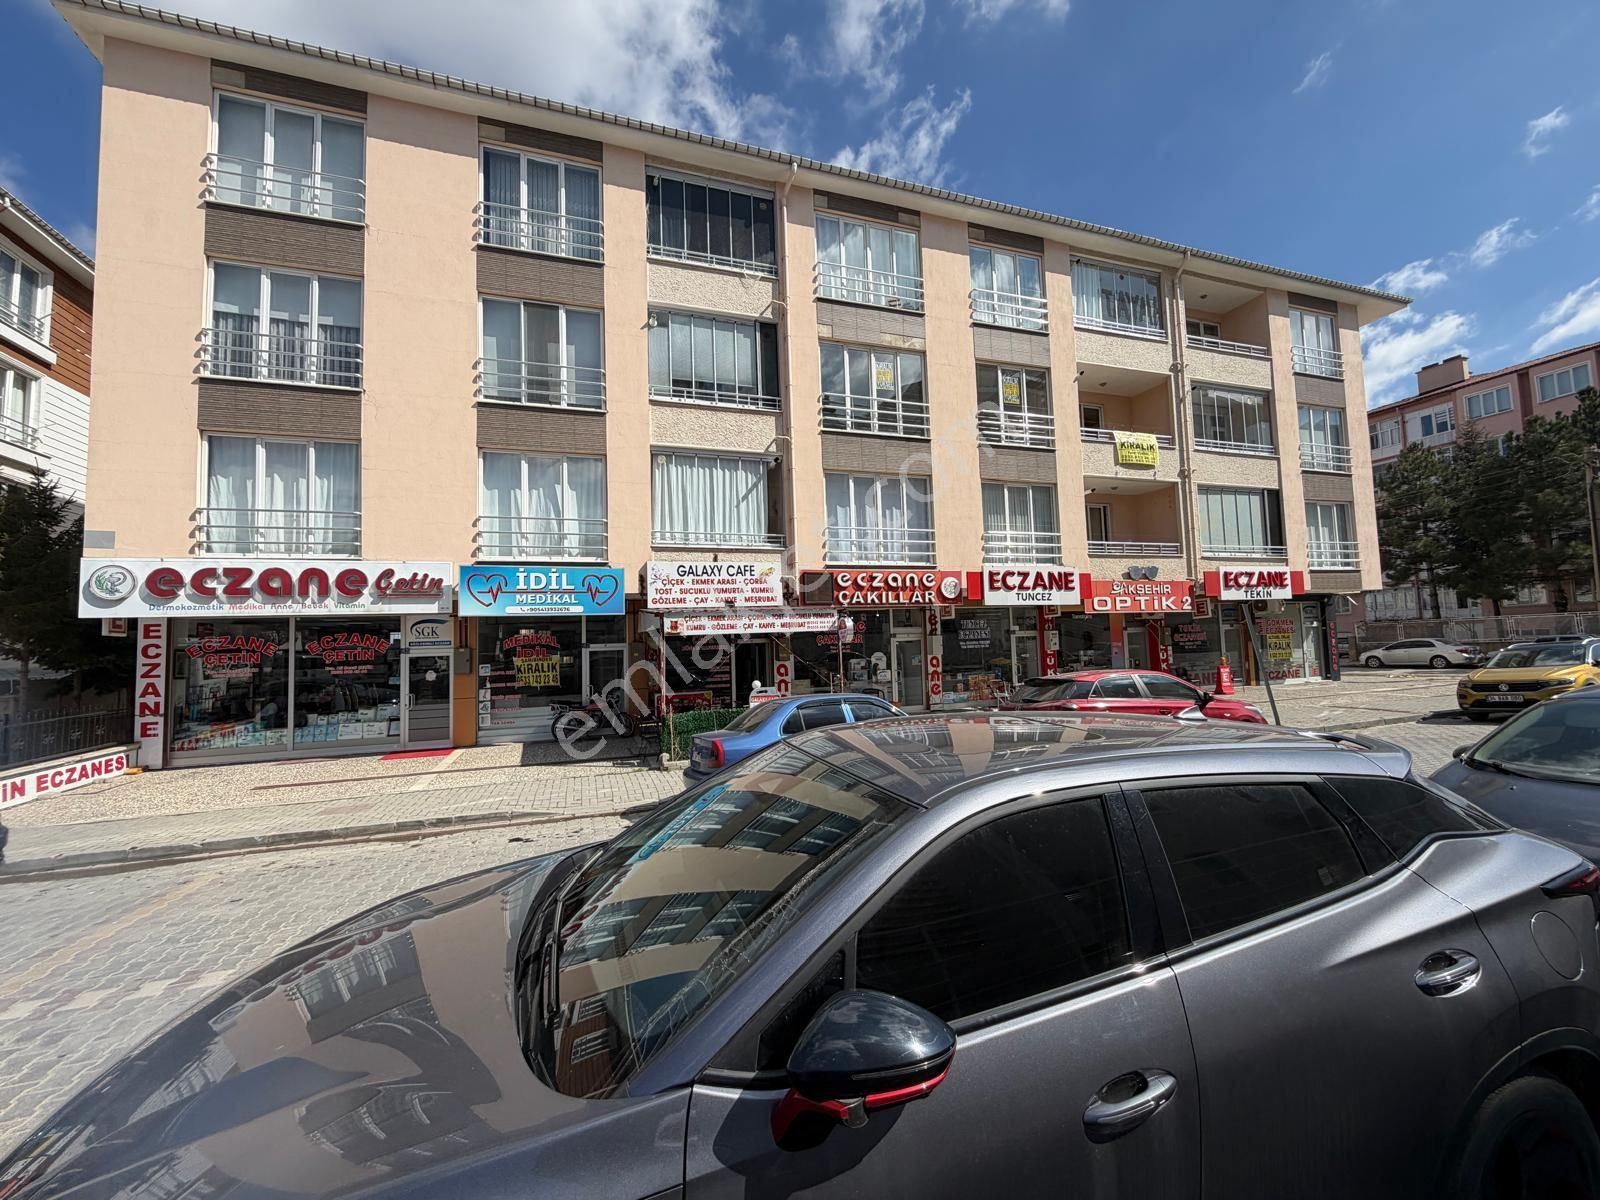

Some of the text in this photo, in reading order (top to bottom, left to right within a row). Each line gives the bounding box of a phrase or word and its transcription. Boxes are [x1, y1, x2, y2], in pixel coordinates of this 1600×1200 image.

[677, 565, 755, 577] GALAXY CAFE
[145, 567, 369, 598] eczane
[516, 568, 575, 590] İDİL
[661, 578, 685, 587] ÇİÇEK
[691, 578, 716, 586] EKMEK
[743, 577, 767, 586] ÇORBA
[837, 572, 936, 587] eczane
[988, 570, 1076, 591] ECZANE
[1223, 570, 1289, 589] ECZANE
[515, 591, 579, 604] MEDİKAL
[680, 587, 711, 595] SUCUKLU
[838, 590, 936, 606] ÇAKILLAR
[1016, 592, 1053, 602] TUNCEZ
[1243, 588, 1272, 599] TEKİN
[651, 596, 687, 604] GÖZLEME
[694, 597, 709, 605] ÇAY
[744, 595, 778, 604] MEŞRUBAT
[1182, 596, 1192, 610] 2
[414, 626, 439, 637] SGK
[185, 635, 279, 660] ECZANE
[305, 632, 392, 656] ECZANE
[322, 647, 375, 664] ÇETİN
[138, 623, 163, 739] ECZANE
